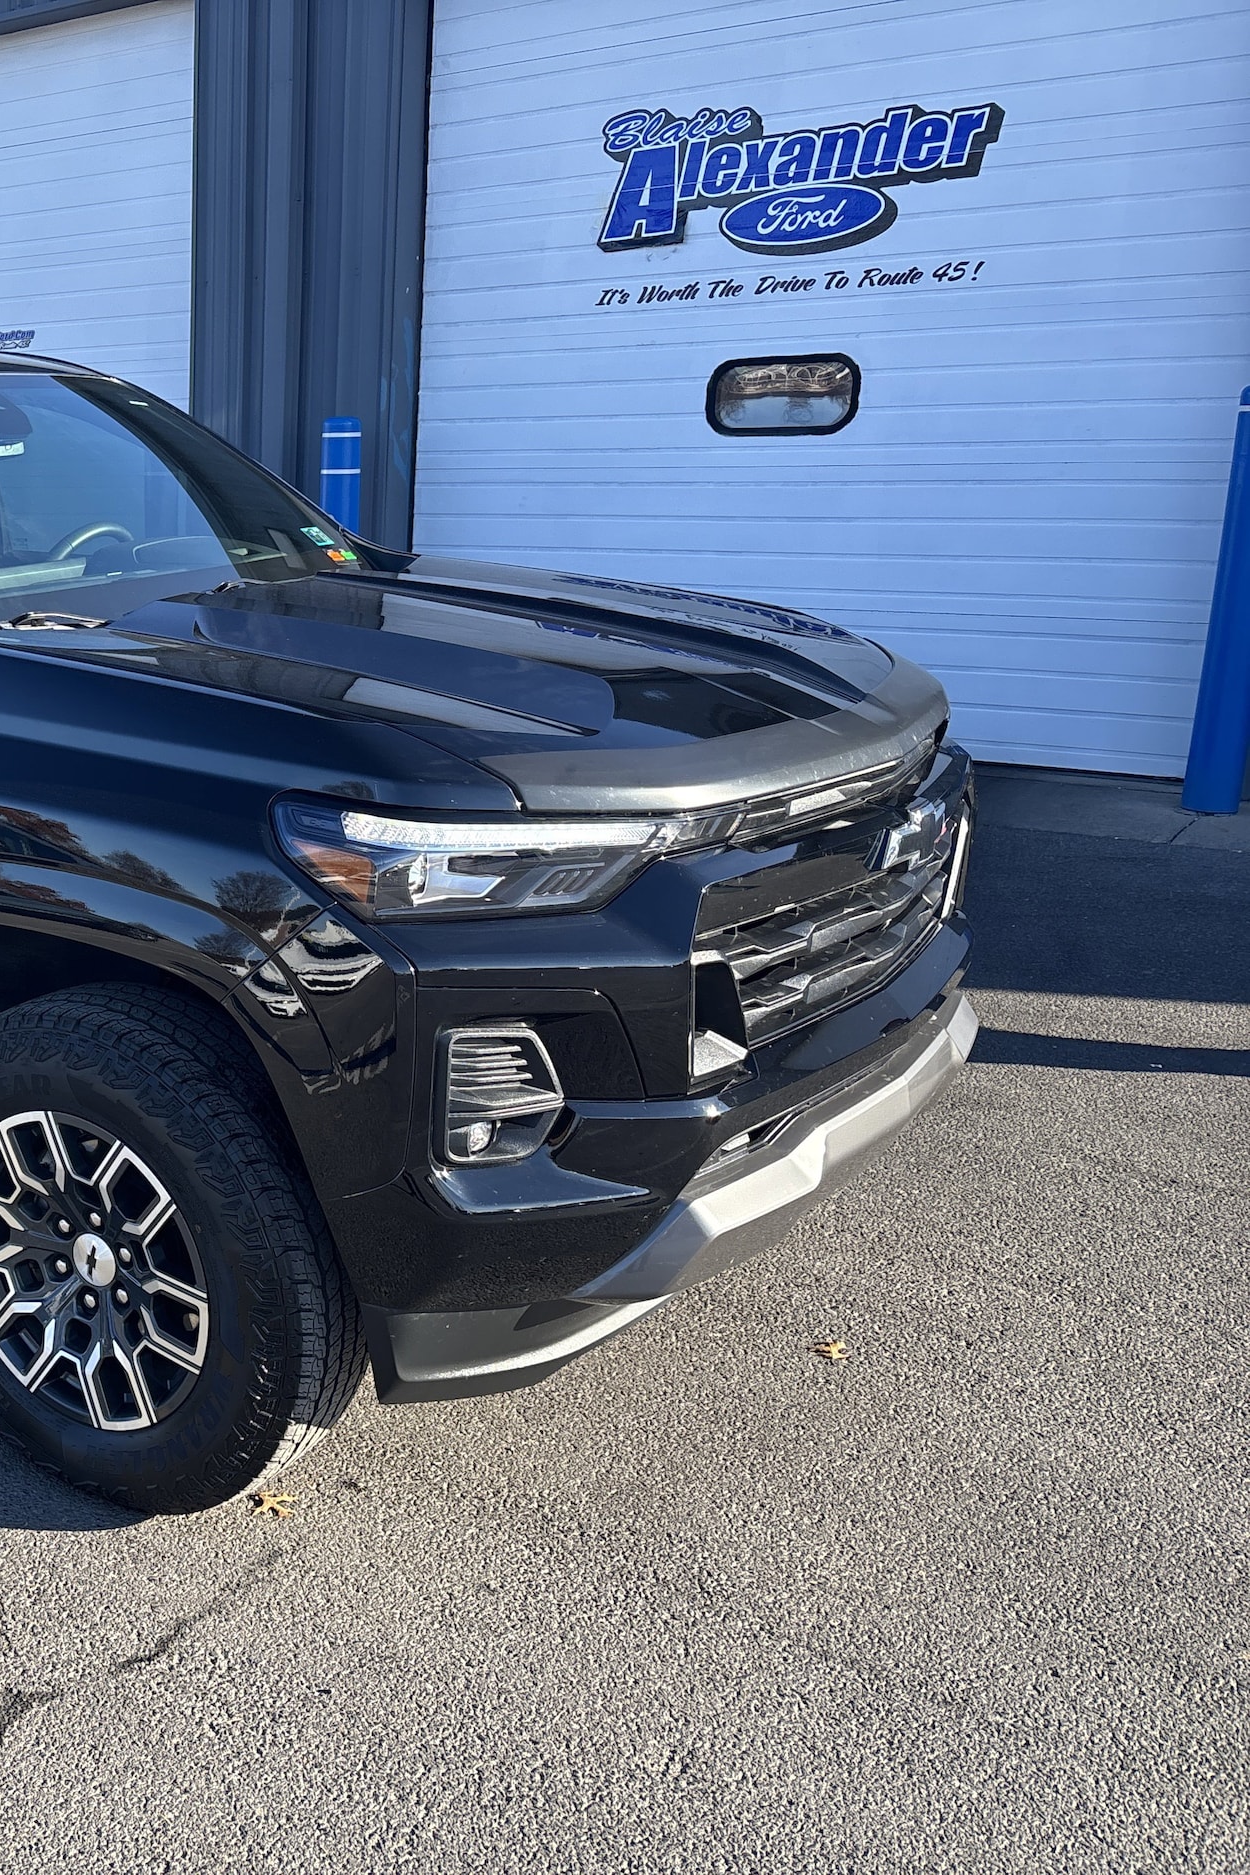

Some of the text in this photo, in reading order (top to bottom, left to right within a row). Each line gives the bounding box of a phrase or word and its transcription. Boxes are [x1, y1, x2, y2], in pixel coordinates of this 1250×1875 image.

[604, 109, 752, 152] Blaise
[600, 105, 994, 243] Alexander
[756, 194, 845, 236] Ford
[595, 287, 630, 306] It's
[636, 281, 700, 304] Worth
[707, 278, 744, 299] The
[754, 275, 816, 295] Drive
[824, 270, 849, 290] To
[857, 266, 924, 288] Route
